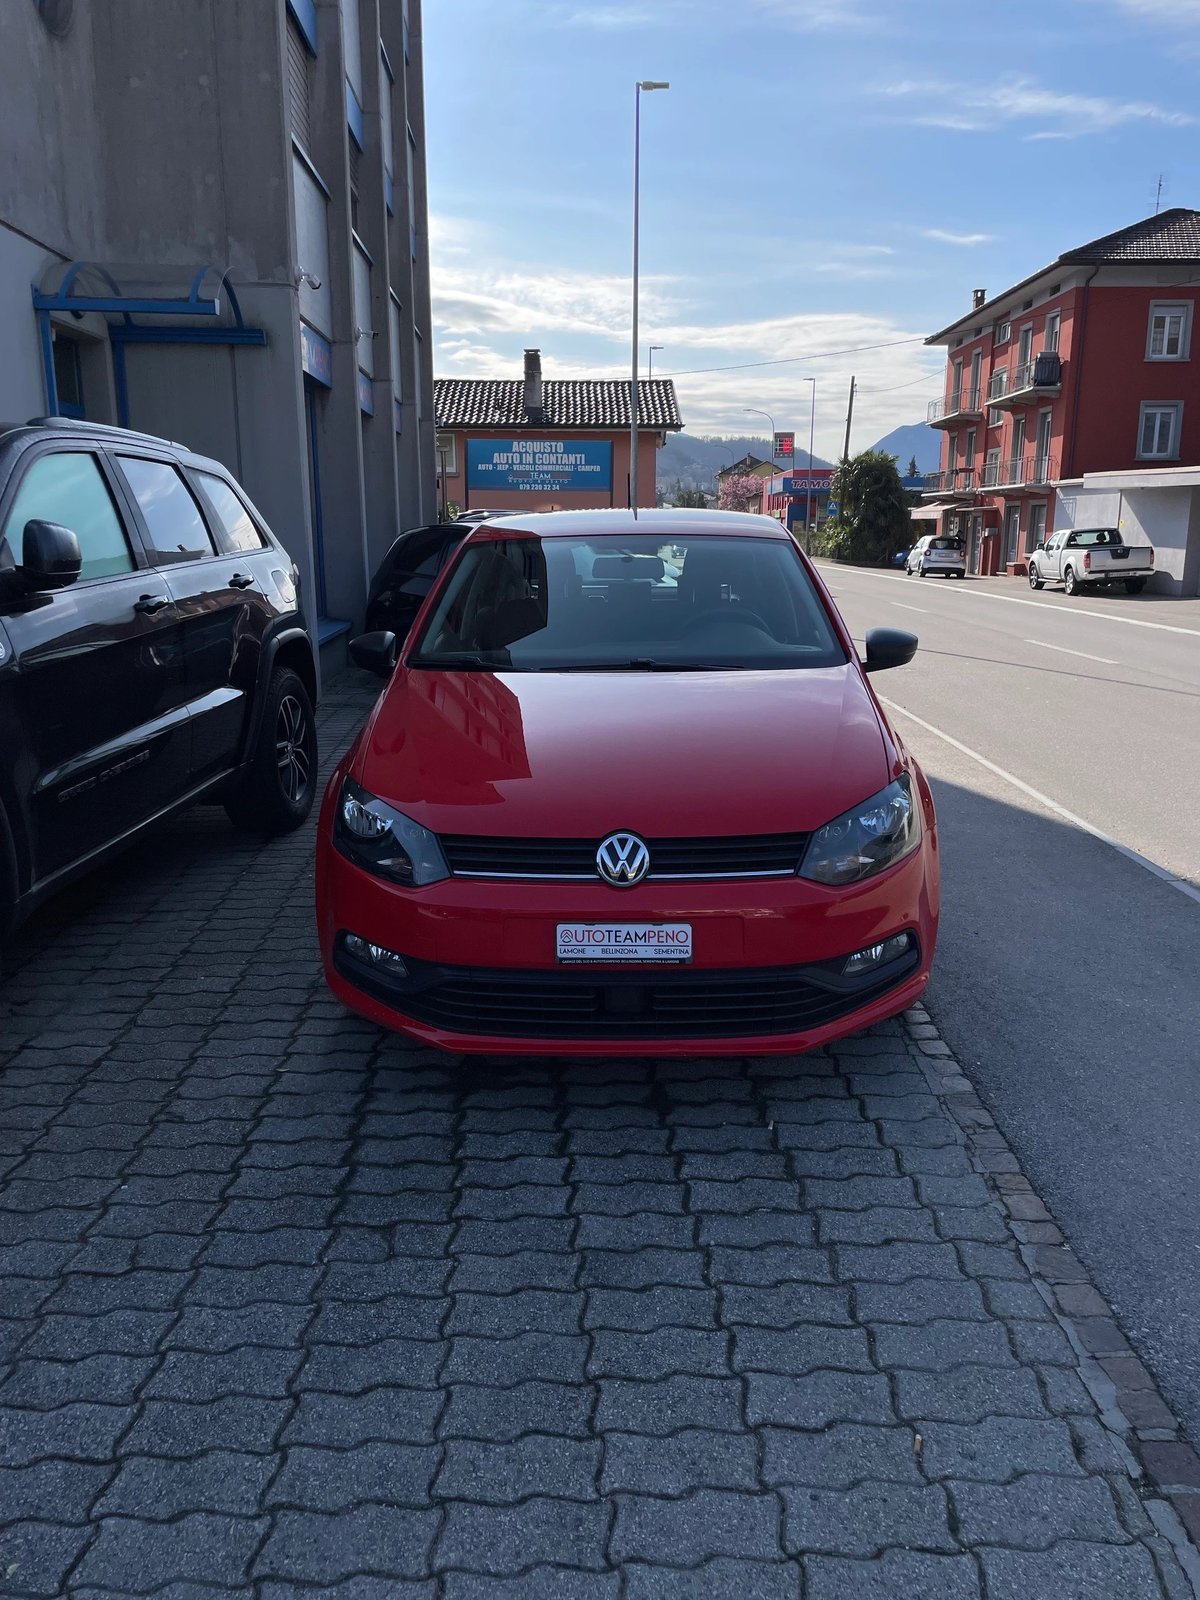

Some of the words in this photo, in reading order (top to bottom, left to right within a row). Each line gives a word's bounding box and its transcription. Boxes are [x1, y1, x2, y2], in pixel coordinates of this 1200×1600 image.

[512, 442, 564, 453] ACQUISTO
[493, 453, 520, 464] AUTO
[523, 453, 534, 464] IN
[535, 454, 585, 465] CONTANTI
[792, 480, 832, 489] TAMO
